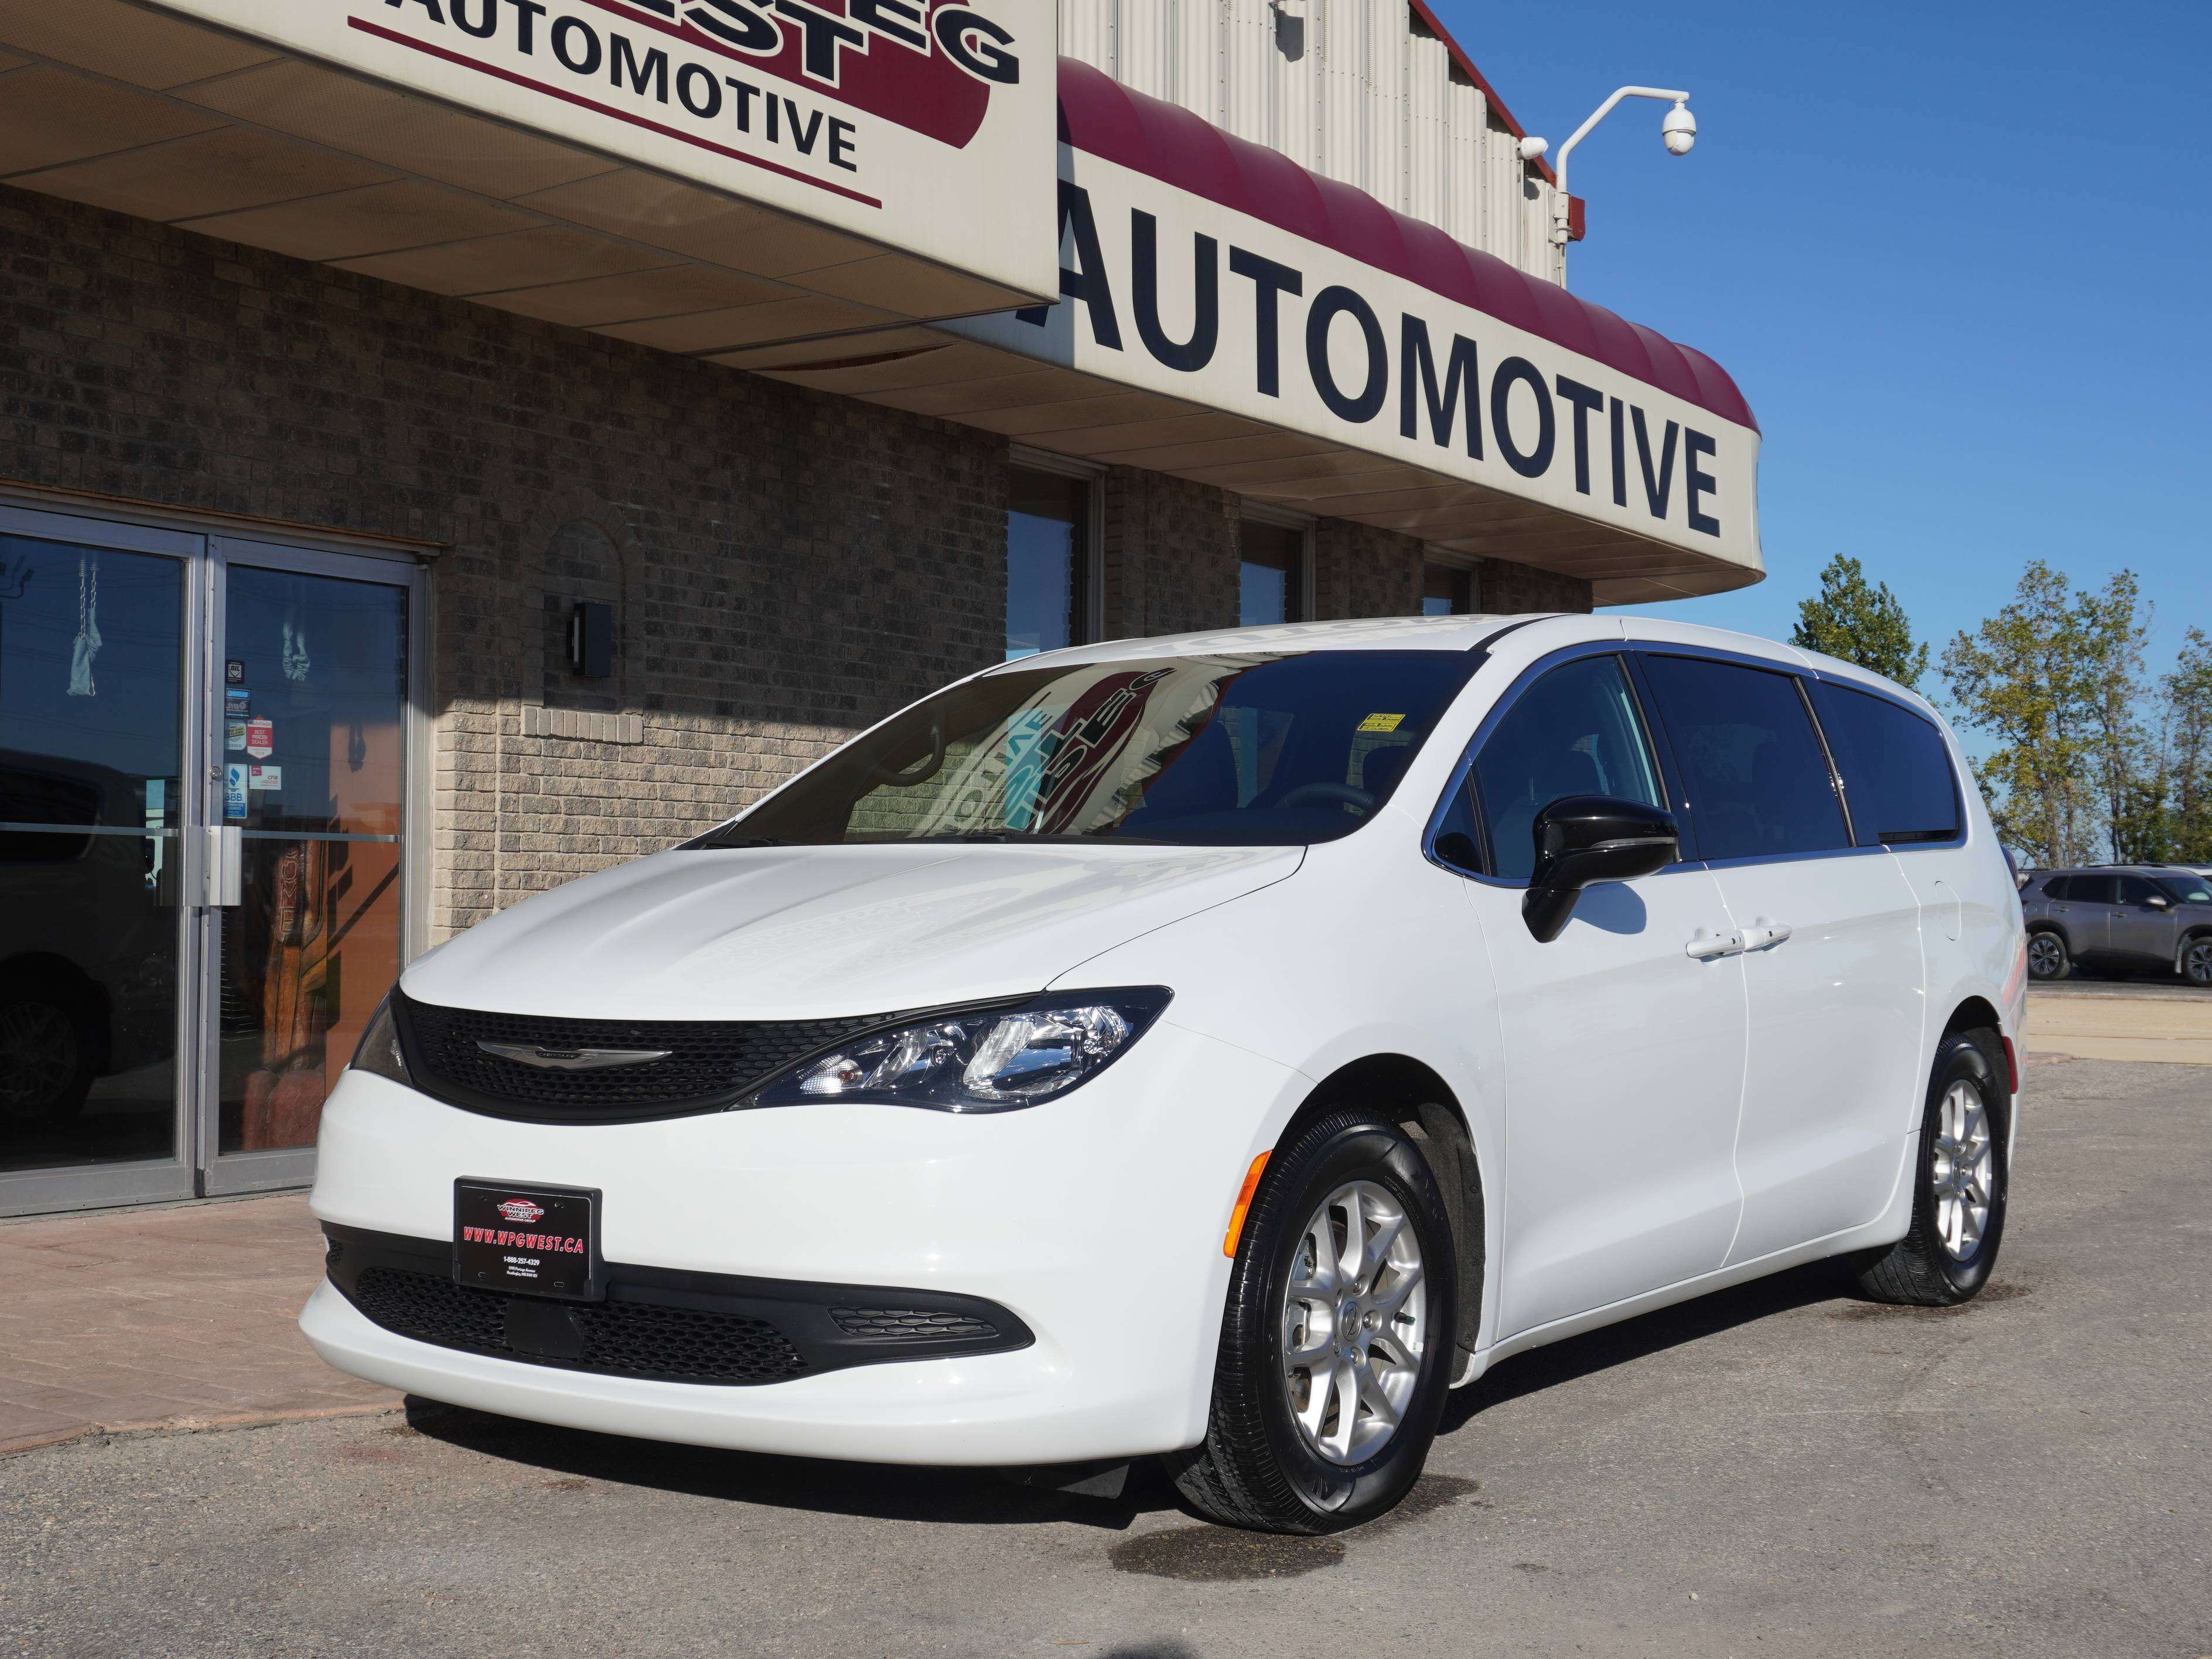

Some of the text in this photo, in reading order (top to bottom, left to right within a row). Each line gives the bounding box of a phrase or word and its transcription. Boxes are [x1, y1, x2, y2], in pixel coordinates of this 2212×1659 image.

[1015, 178, 1720, 537] AUTOMOTIVE
[497, 1204, 544, 1215] WINNIPEG
[463, 1226, 583, 1254] WWW.WPGWEST.CA
